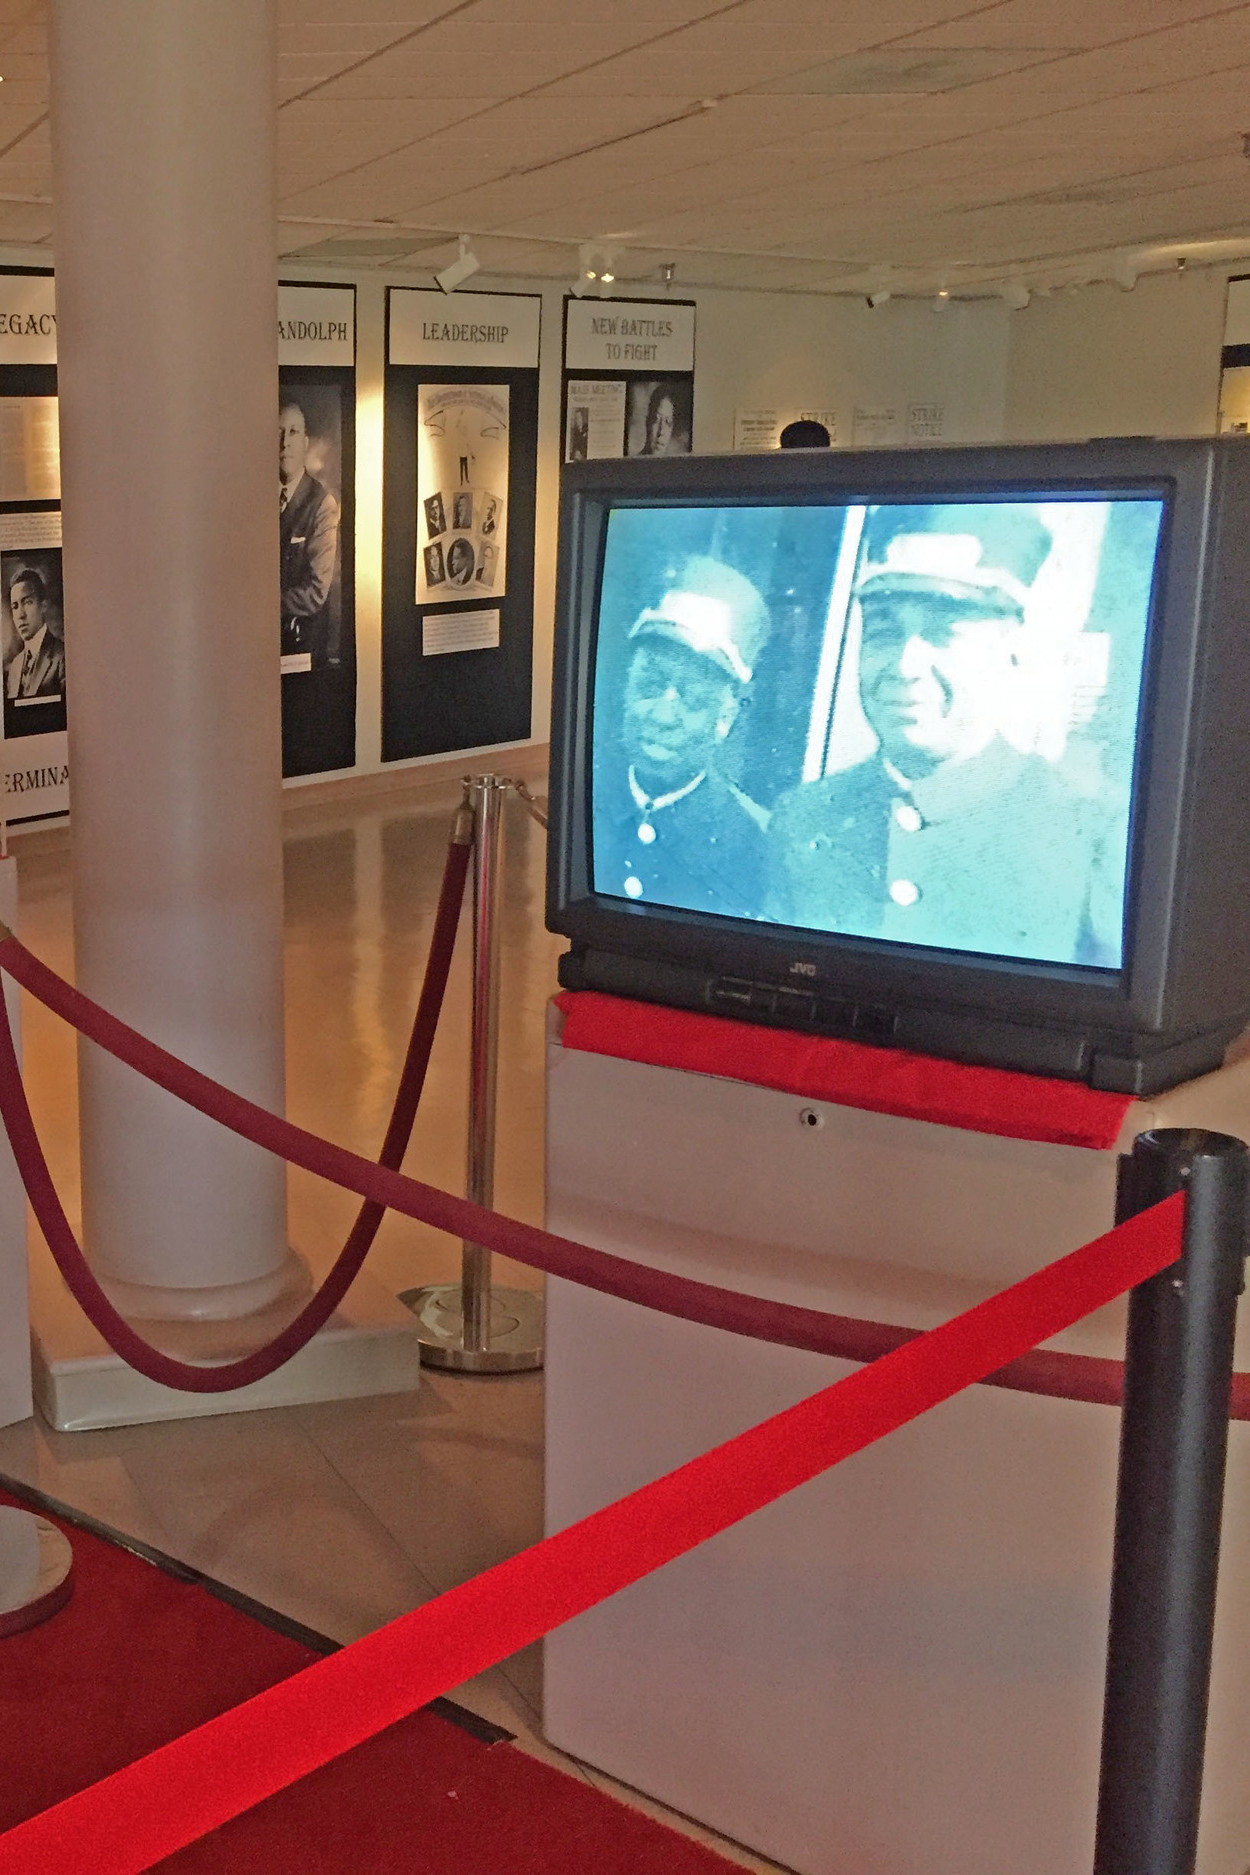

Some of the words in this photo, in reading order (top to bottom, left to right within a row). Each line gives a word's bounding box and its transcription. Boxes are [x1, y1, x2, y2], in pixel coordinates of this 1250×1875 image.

[422, 322, 509, 344] LEADERSHIP
[591, 316, 619, 334] NEW
[620, 318, 673, 337] BATTLES
[606, 343, 622, 360] TO
[623, 344, 658, 361] FIGHT
[789, 962, 817, 977] JVC
